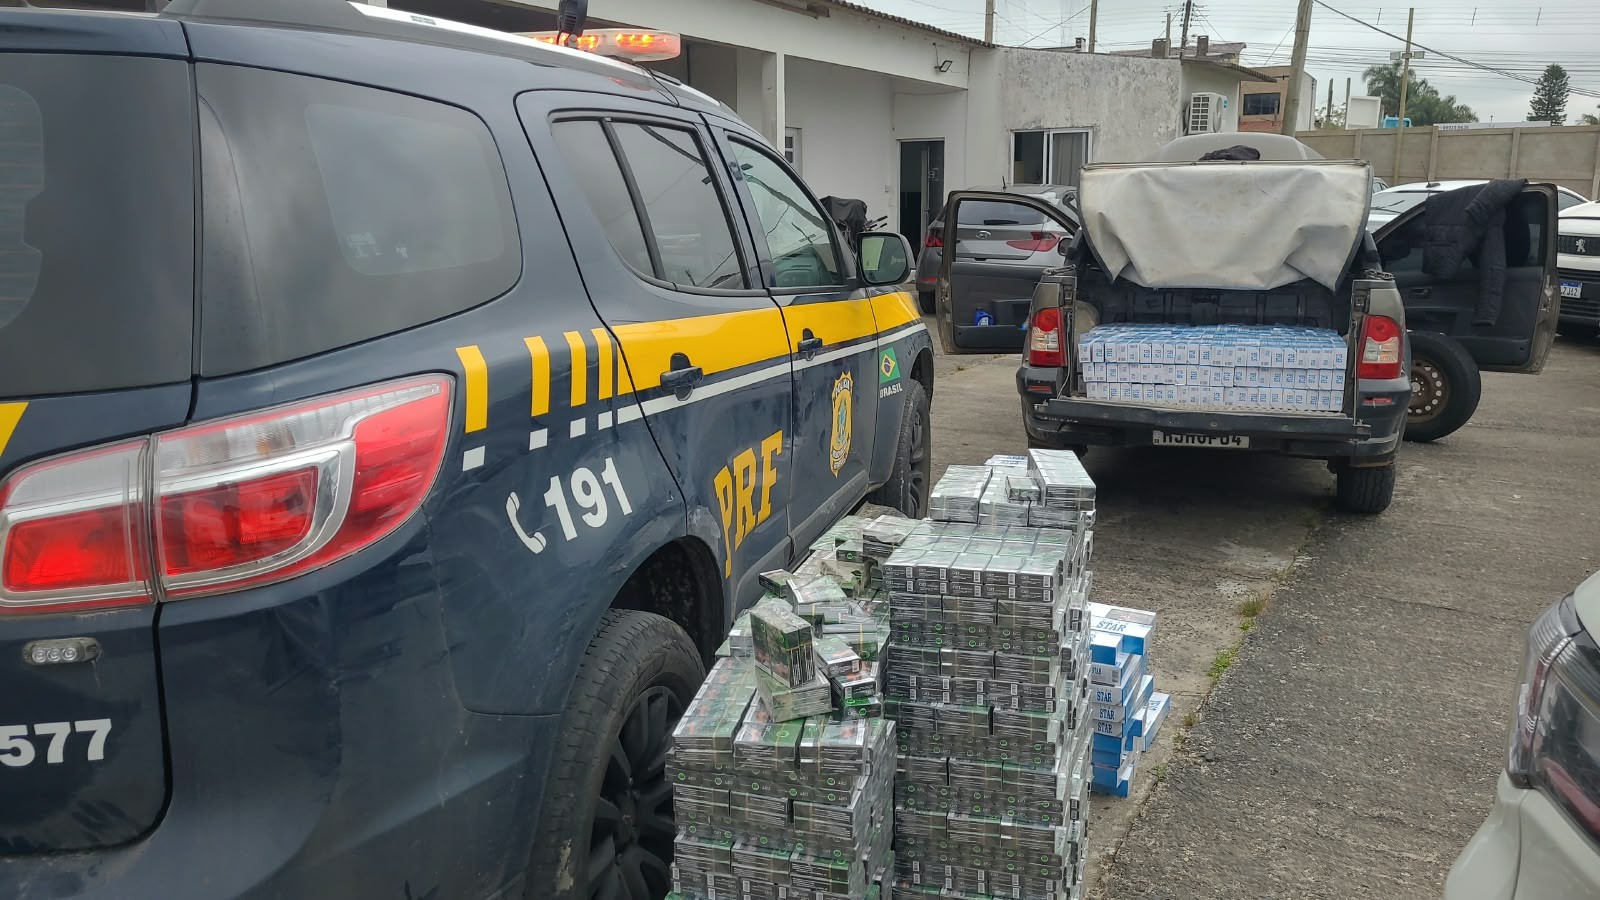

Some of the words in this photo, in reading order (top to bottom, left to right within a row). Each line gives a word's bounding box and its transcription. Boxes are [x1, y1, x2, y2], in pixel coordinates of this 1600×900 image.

[879, 382, 903, 399] BRASIL
[543, 456, 633, 542] 191
[713, 429, 783, 580] PRF
[1096, 620, 1126, 632] STAR
[1096, 691, 1113, 703] STAR
[1099, 708, 1115, 720] STAR
[1097, 721, 1113, 734] STAR
[0, 718, 112, 767] 577
